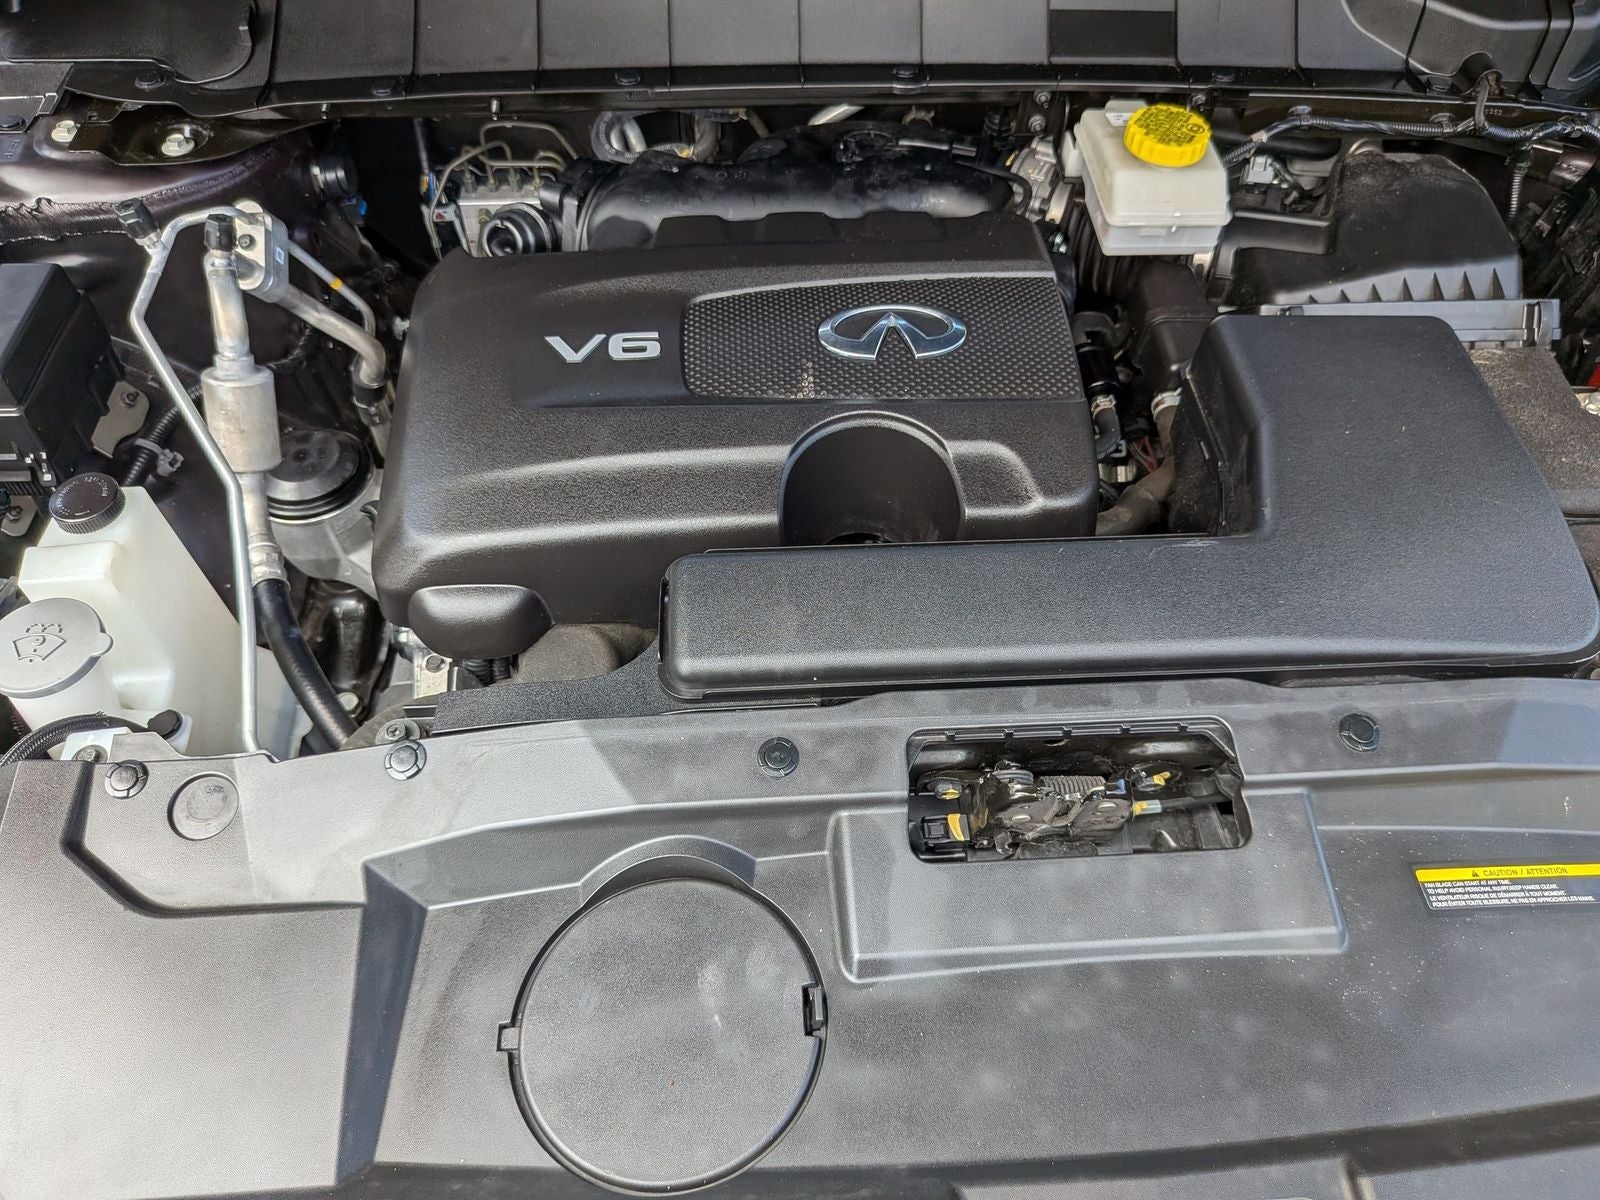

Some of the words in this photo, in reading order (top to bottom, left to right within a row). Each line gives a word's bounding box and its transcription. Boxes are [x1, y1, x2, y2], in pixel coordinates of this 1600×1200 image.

[544, 332, 661, 363] V6
[1483, 869, 1518, 877] CAUTION
[1526, 867, 1568, 875] ATTENTION
